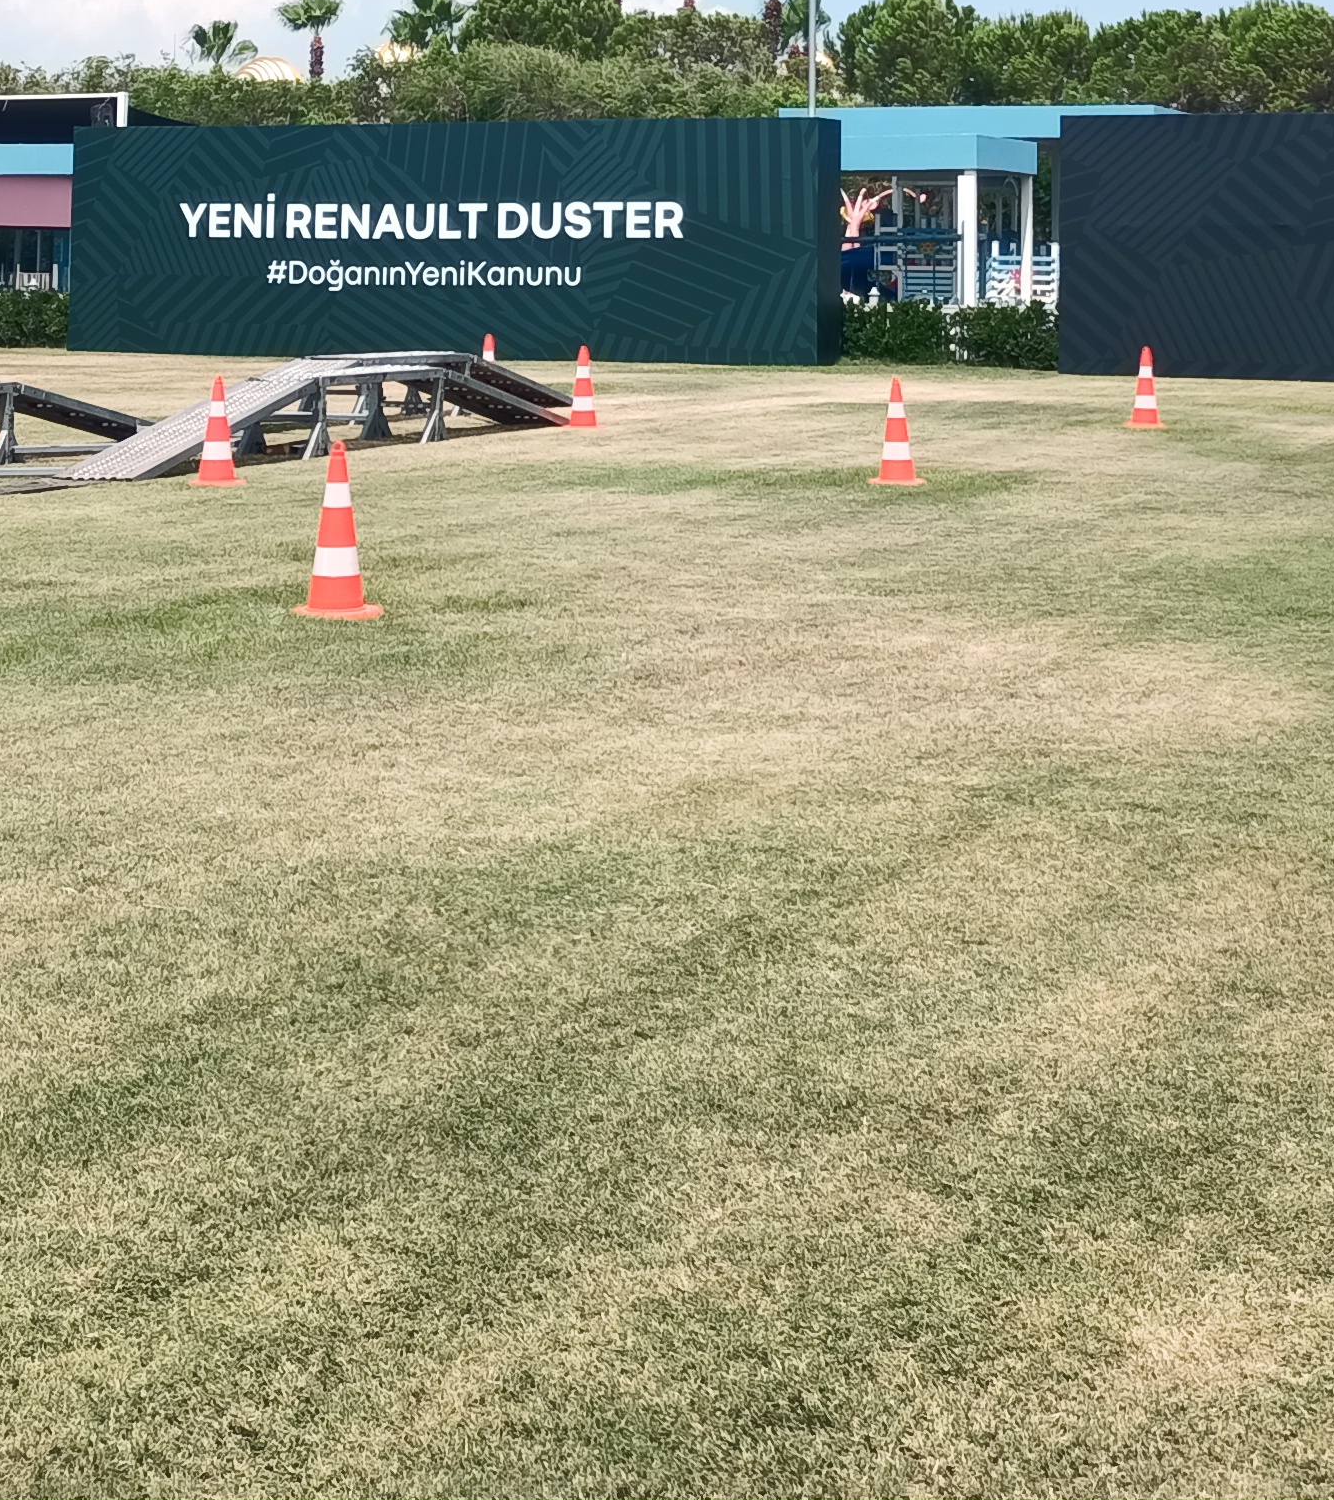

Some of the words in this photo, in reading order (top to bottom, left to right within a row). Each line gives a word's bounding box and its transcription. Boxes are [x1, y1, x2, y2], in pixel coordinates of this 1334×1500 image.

[179, 192, 276, 239] YENİ
[285, 202, 488, 240] RENAULT
[497, 201, 684, 240] DUSTER
[266, 258, 582, 292] #DoğanınYeniKanunu
